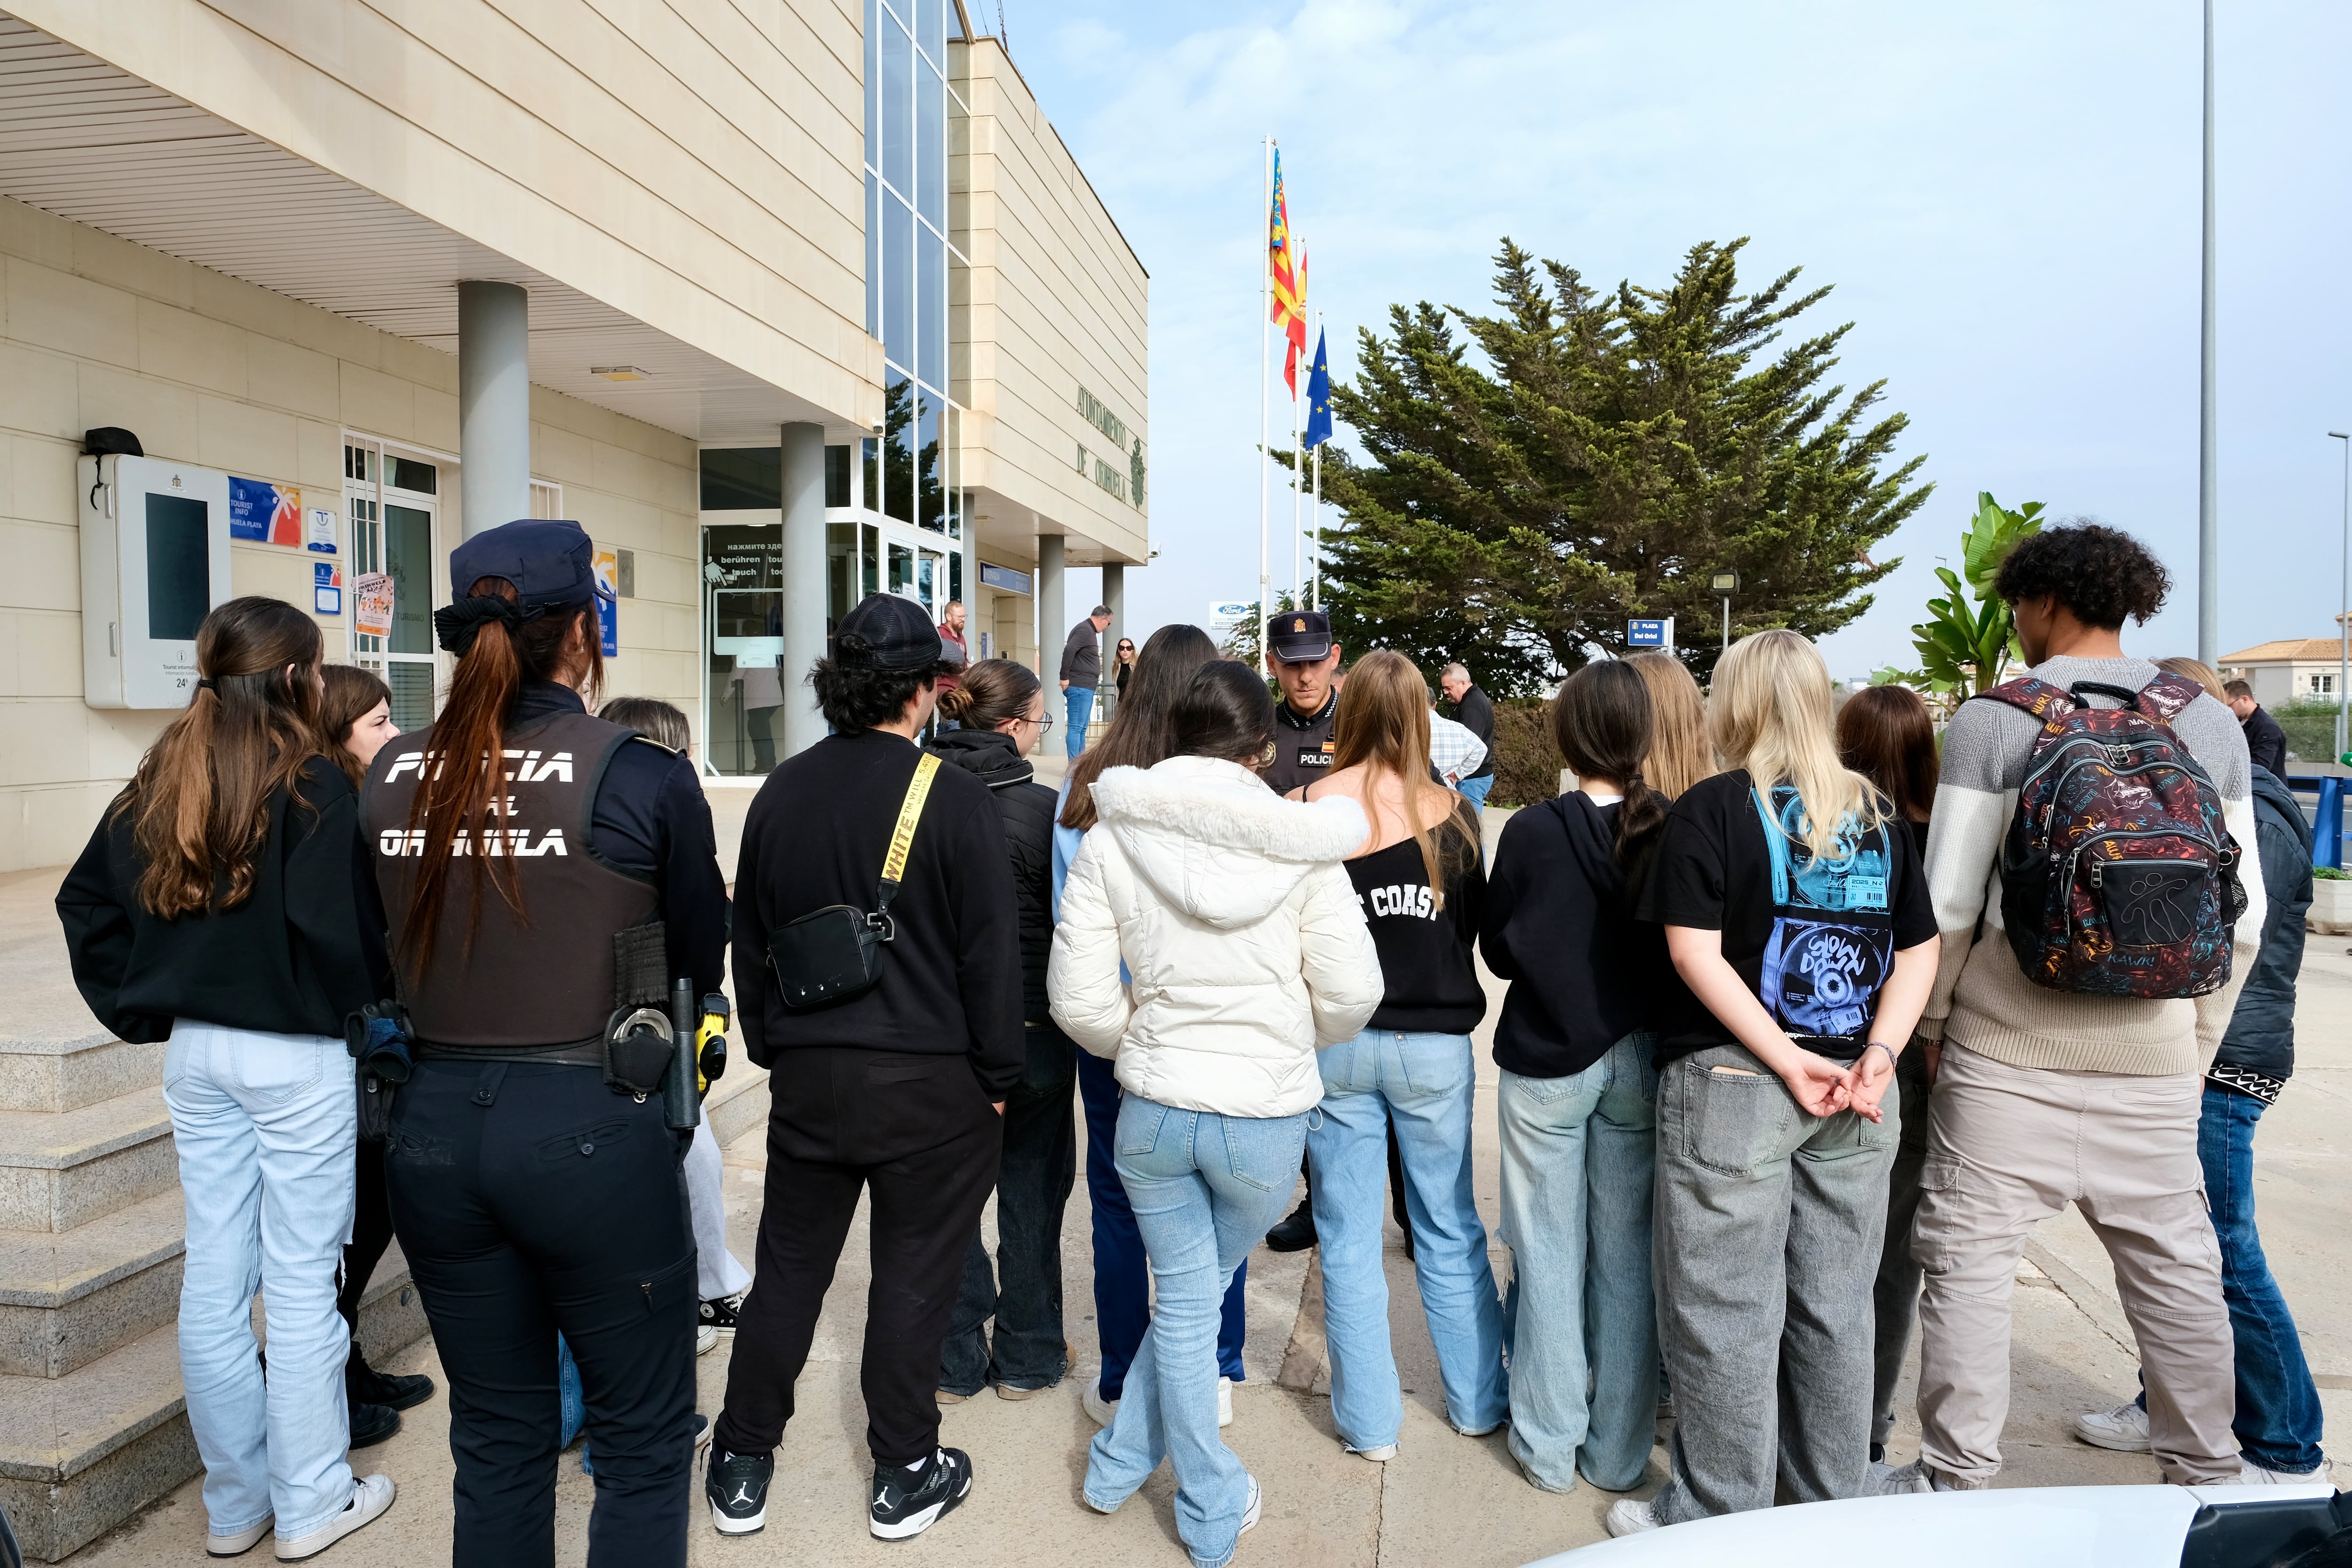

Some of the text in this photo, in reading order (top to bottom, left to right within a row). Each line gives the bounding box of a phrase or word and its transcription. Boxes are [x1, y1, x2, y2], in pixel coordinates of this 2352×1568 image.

[1076, 385, 1126, 450] AYUNTAMIENTO
[1077, 444, 1126, 503] DE ORIHUELA
[230, 500, 253, 509] TOURIST
[397, 613, 424, 622] TURISMO
[1223, 605, 1242, 614] Ford
[2074, 788, 2098, 814] RAWR!
[886, 816, 914, 881] WHITE
[909, 779, 922, 799] WILL
[2107, 954, 2155, 967] RAWR!
